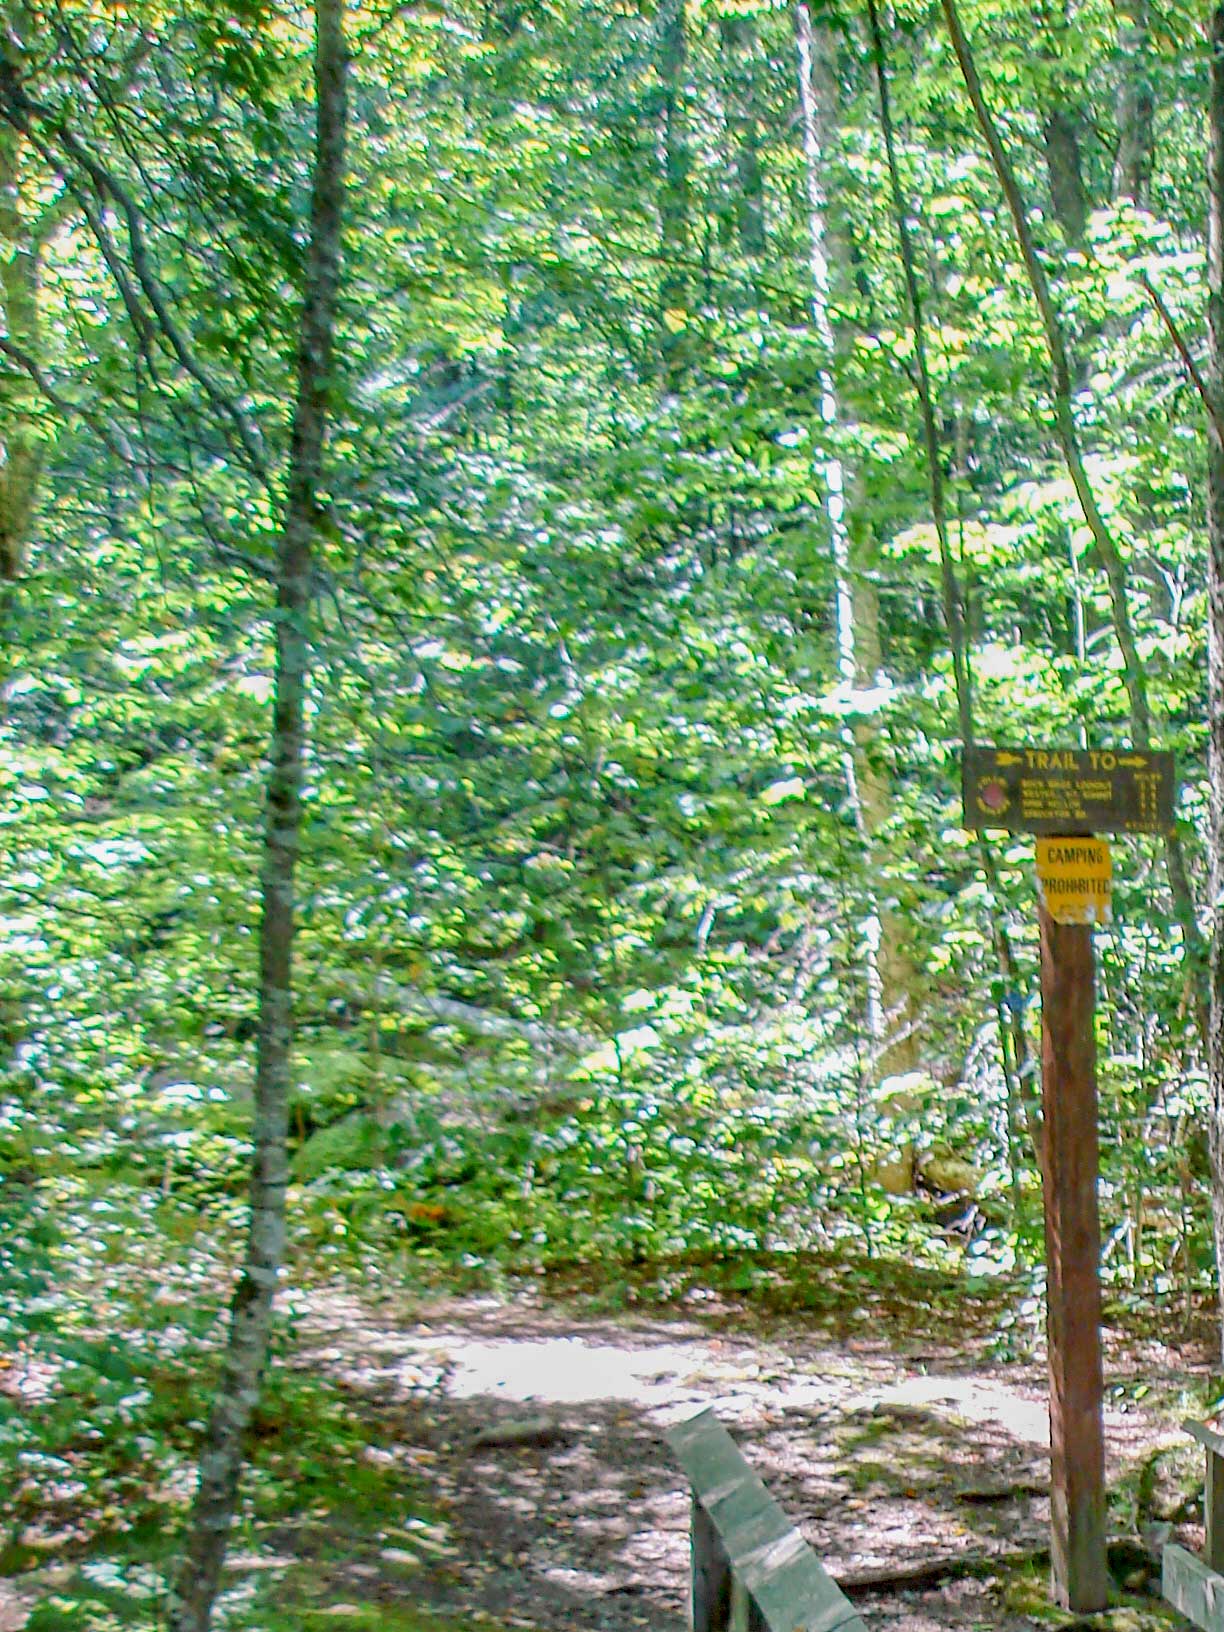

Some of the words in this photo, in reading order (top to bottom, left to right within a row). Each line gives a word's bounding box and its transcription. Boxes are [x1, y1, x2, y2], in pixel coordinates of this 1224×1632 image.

[1025, 751, 1079, 770] TRAIL
[1089, 752, 1117, 770] TO
[1047, 846, 1103, 865] CAMPING
[1042, 878, 1111, 895] PROHIBITED
